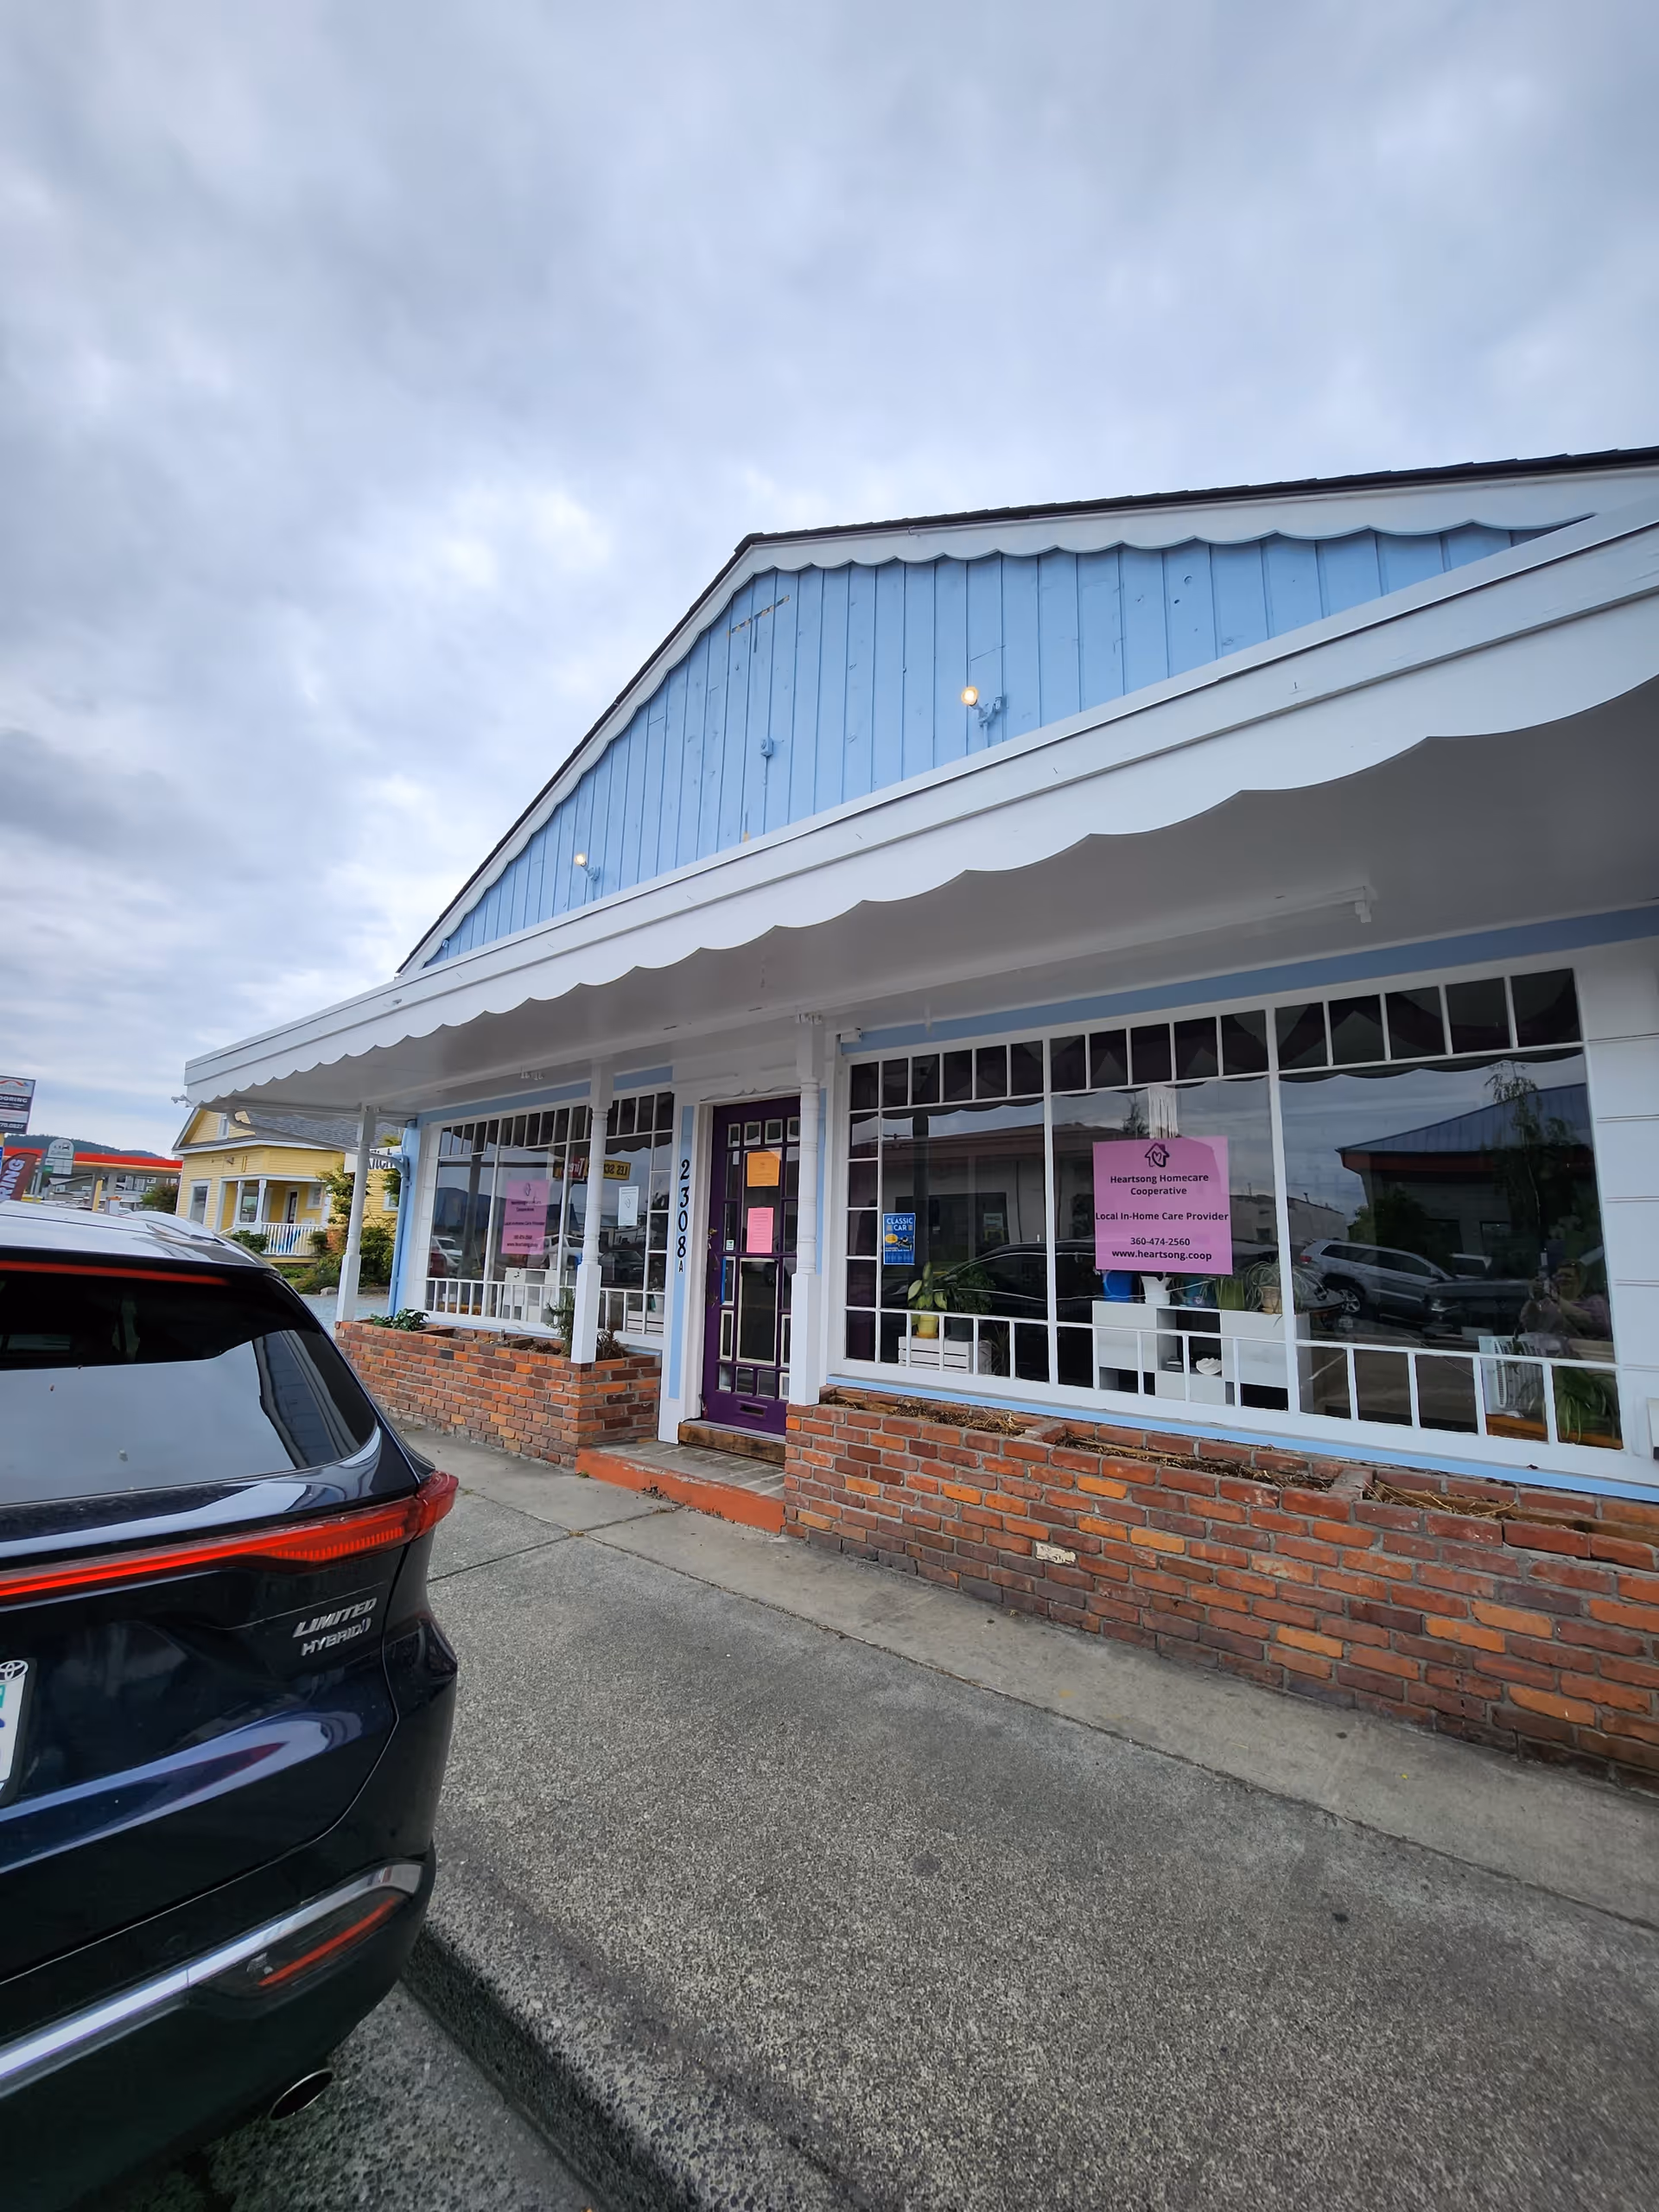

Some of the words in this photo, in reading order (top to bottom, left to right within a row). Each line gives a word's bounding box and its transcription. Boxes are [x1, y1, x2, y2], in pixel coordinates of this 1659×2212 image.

[1110, 1175, 1157, 1185] Heartsong
[1130, 1187, 1187, 1197] Cooperative
[677, 1159, 690, 1258] 2308
[1186, 1212, 1229, 1221] Provider
[1130, 1237, 1191, 1246] 360-474-2560
[1112, 1249, 1212, 1262] www.heartsong.coop
[292, 1598, 378, 1638] LIMITED
[301, 1624, 362, 1656] HYBRID
